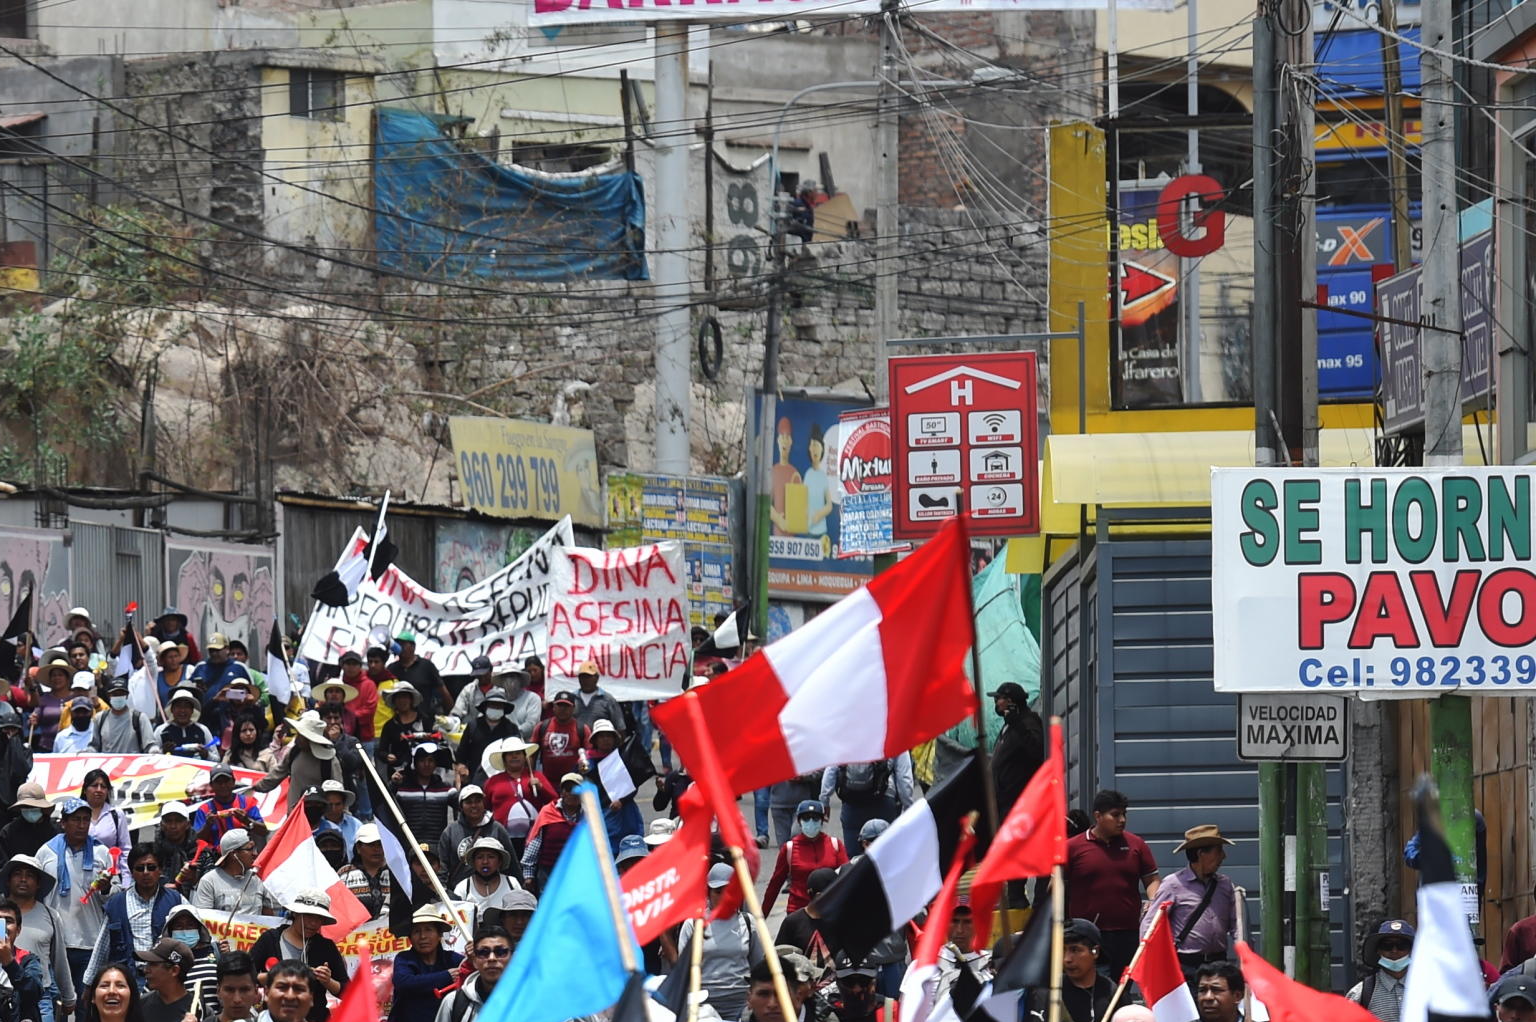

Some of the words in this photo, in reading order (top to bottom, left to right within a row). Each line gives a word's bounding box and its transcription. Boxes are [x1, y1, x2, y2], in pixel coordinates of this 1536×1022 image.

[1349, 290, 1367, 304] 90
[1345, 354, 1364, 368] 95
[950, 379, 974, 406] H
[460, 450, 496, 508] 960
[496, 452, 529, 511] 299
[529, 455, 561, 514] 799
[991, 492, 1002, 501] 24
[1239, 478, 1322, 567] SE
[787, 542, 803, 556] 907
[566, 544, 677, 595] DINA
[550, 598, 687, 639] ASESINA
[547, 642, 690, 680] RENUNCIA
[1298, 658, 1375, 687] Cel:
[1248, 705, 1338, 722] VELOCIDAD
[1246, 724, 1340, 746] MAXIMA
[621, 867, 681, 910] ONSTR.
